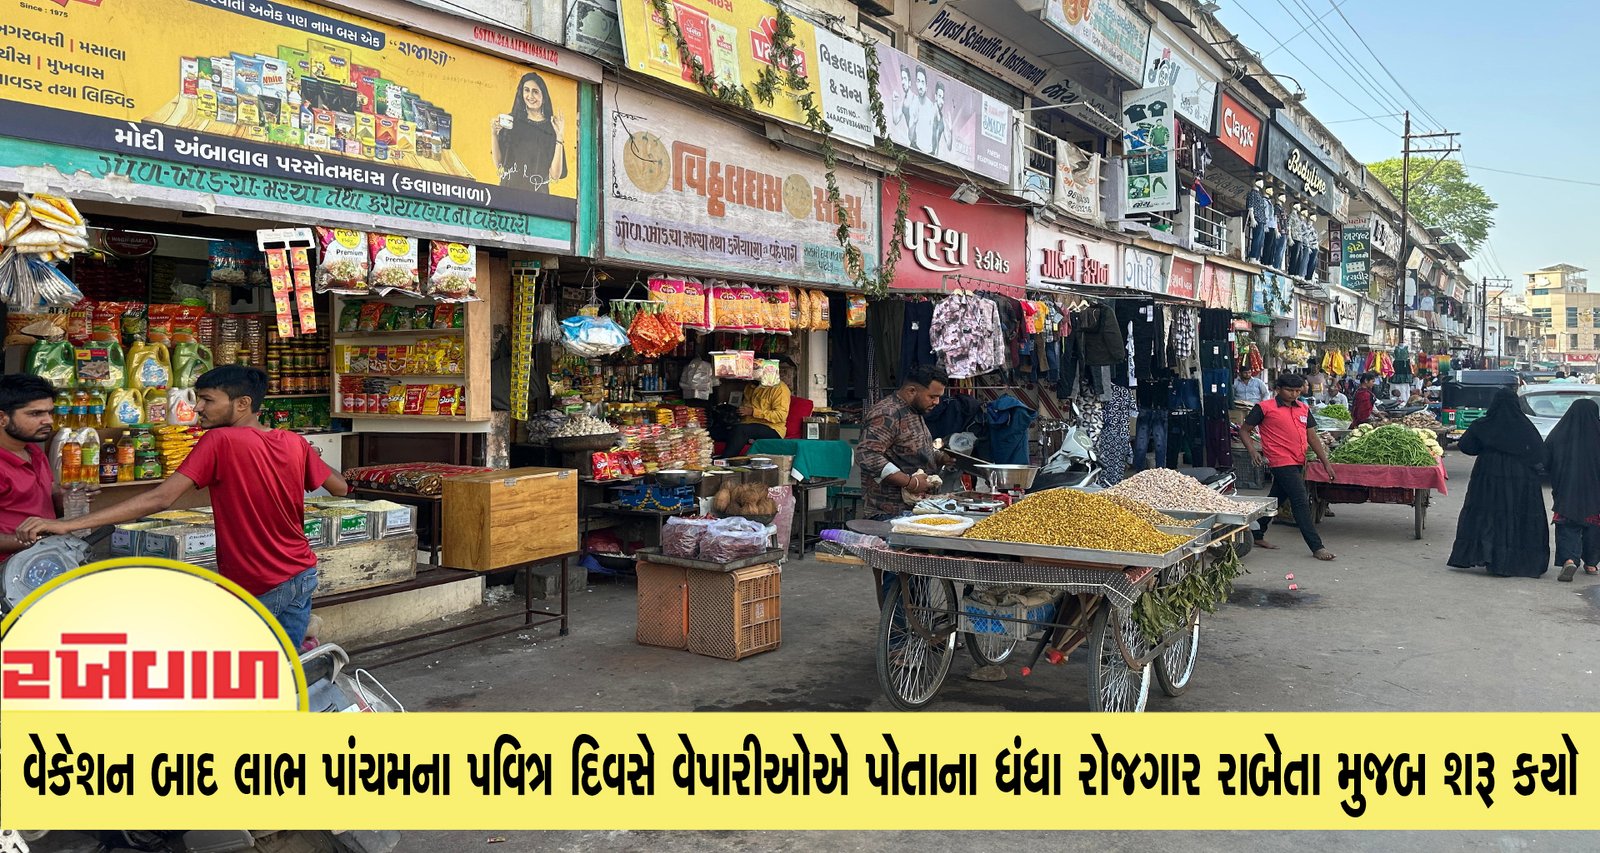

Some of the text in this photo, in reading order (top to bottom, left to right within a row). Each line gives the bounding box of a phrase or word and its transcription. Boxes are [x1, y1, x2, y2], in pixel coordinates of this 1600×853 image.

[20, 2, 42, 12] Since
[49, 9, 68, 18] 1975
[249, 3, 283, 21] અનેક
[286, 13, 307, 28] પણ
[311, 21, 333, 35] નામ
[337, 27, 357, 41] બસ
[361, 31, 380, 47] એક
[928, 9, 967, 41] Piyush
[958, 25, 1003, 60] Scientific
[996, 46, 1011, 63] &
[79, 41, 126, 61] મસાલા
[47, 58, 104, 80] મુખવાસ
[48, 84, 77, 98] તથા
[829, 78, 838, 95] &
[1223, 107, 1255, 147] Classic
[115, 121, 164, 152] મોદી
[174, 136, 268, 169] અંબાલાલ
[275, 153, 385, 187] પરસોતમદાસ
[391, 172, 492, 206] (કલાણાવાળા)
[1287, 148, 1327, 197] Bodyline
[325, 187, 361, 212] તથા
[709, 235, 726, 253] તથા
[902, 205, 969, 272] પરેશ
[974, 247, 1010, 275] રેડીમેડ
